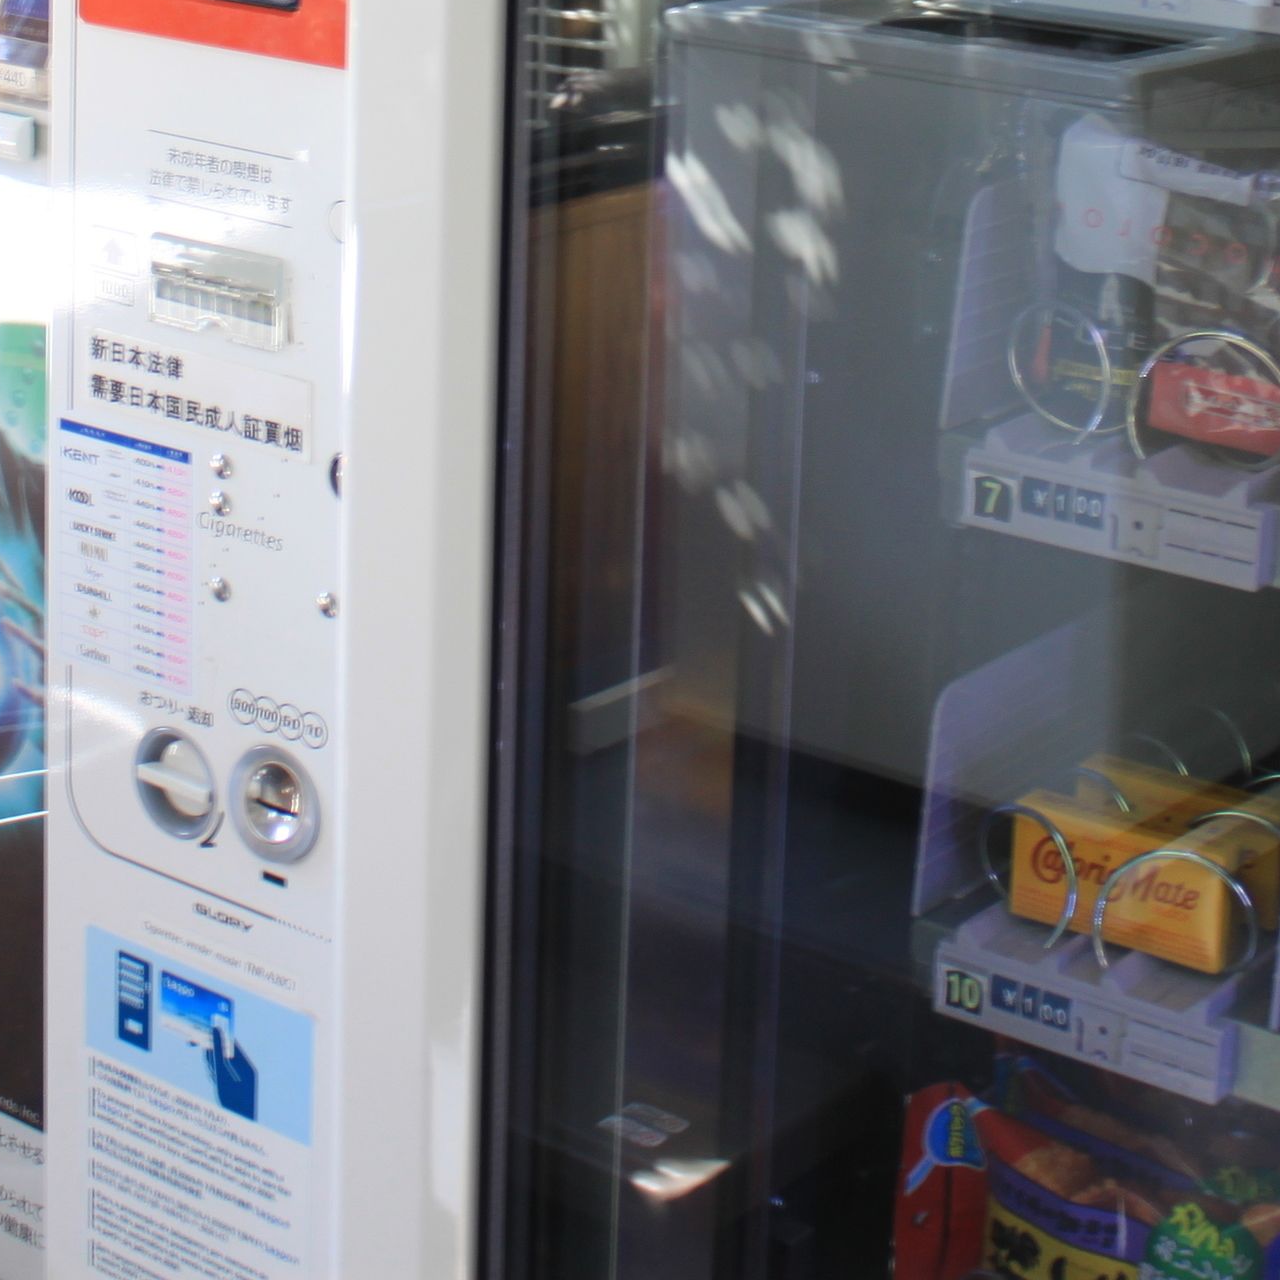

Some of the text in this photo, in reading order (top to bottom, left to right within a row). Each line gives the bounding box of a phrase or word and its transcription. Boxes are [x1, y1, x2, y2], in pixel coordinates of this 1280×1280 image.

[91, 335, 185, 380] 新日本法律
[981, 482, 1001, 514] 7
[196, 509, 285, 553] Cigarettes
[946, 974, 981, 1009] 10
